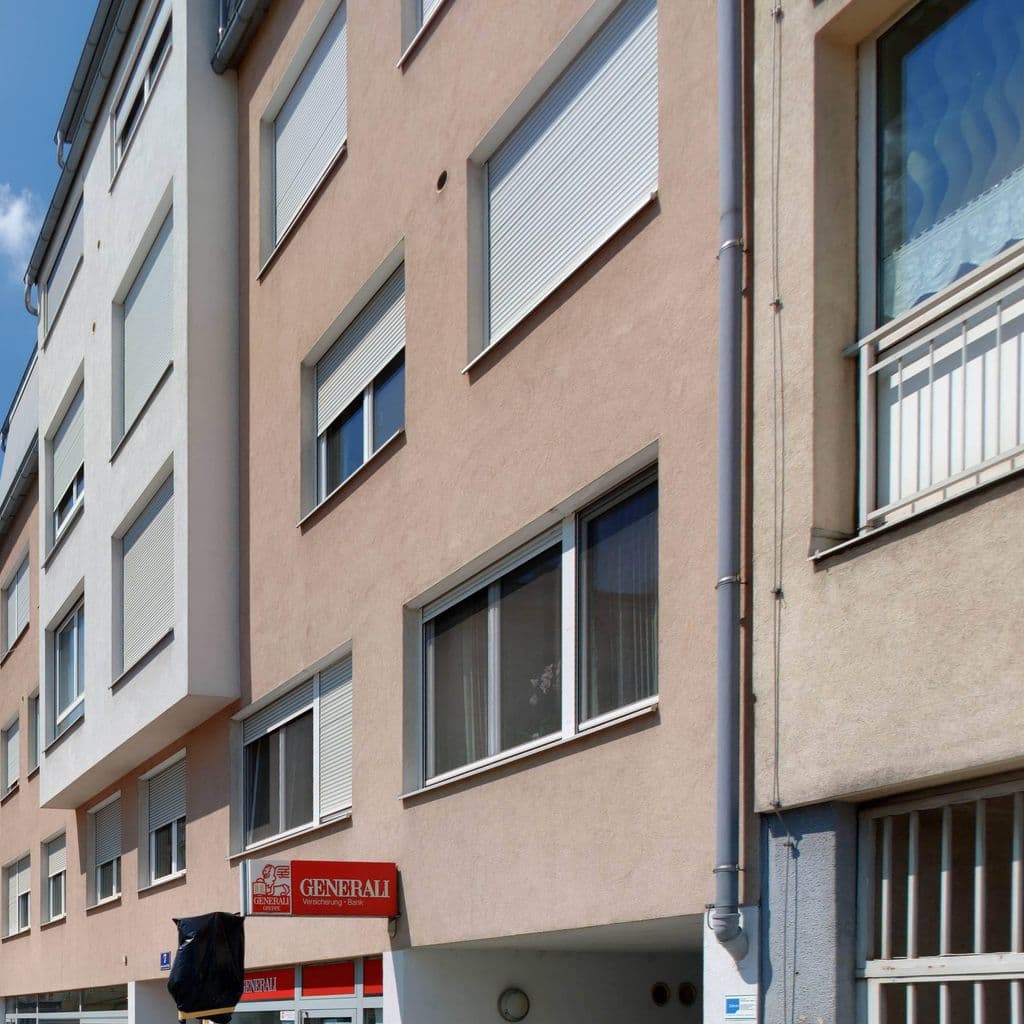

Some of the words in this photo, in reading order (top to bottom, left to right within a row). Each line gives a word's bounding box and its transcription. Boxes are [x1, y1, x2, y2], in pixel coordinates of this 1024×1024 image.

[299, 878, 390, 898] GENERALI
[253, 896, 290, 905] GENERALI
[243, 976, 277, 994] ENERALI
